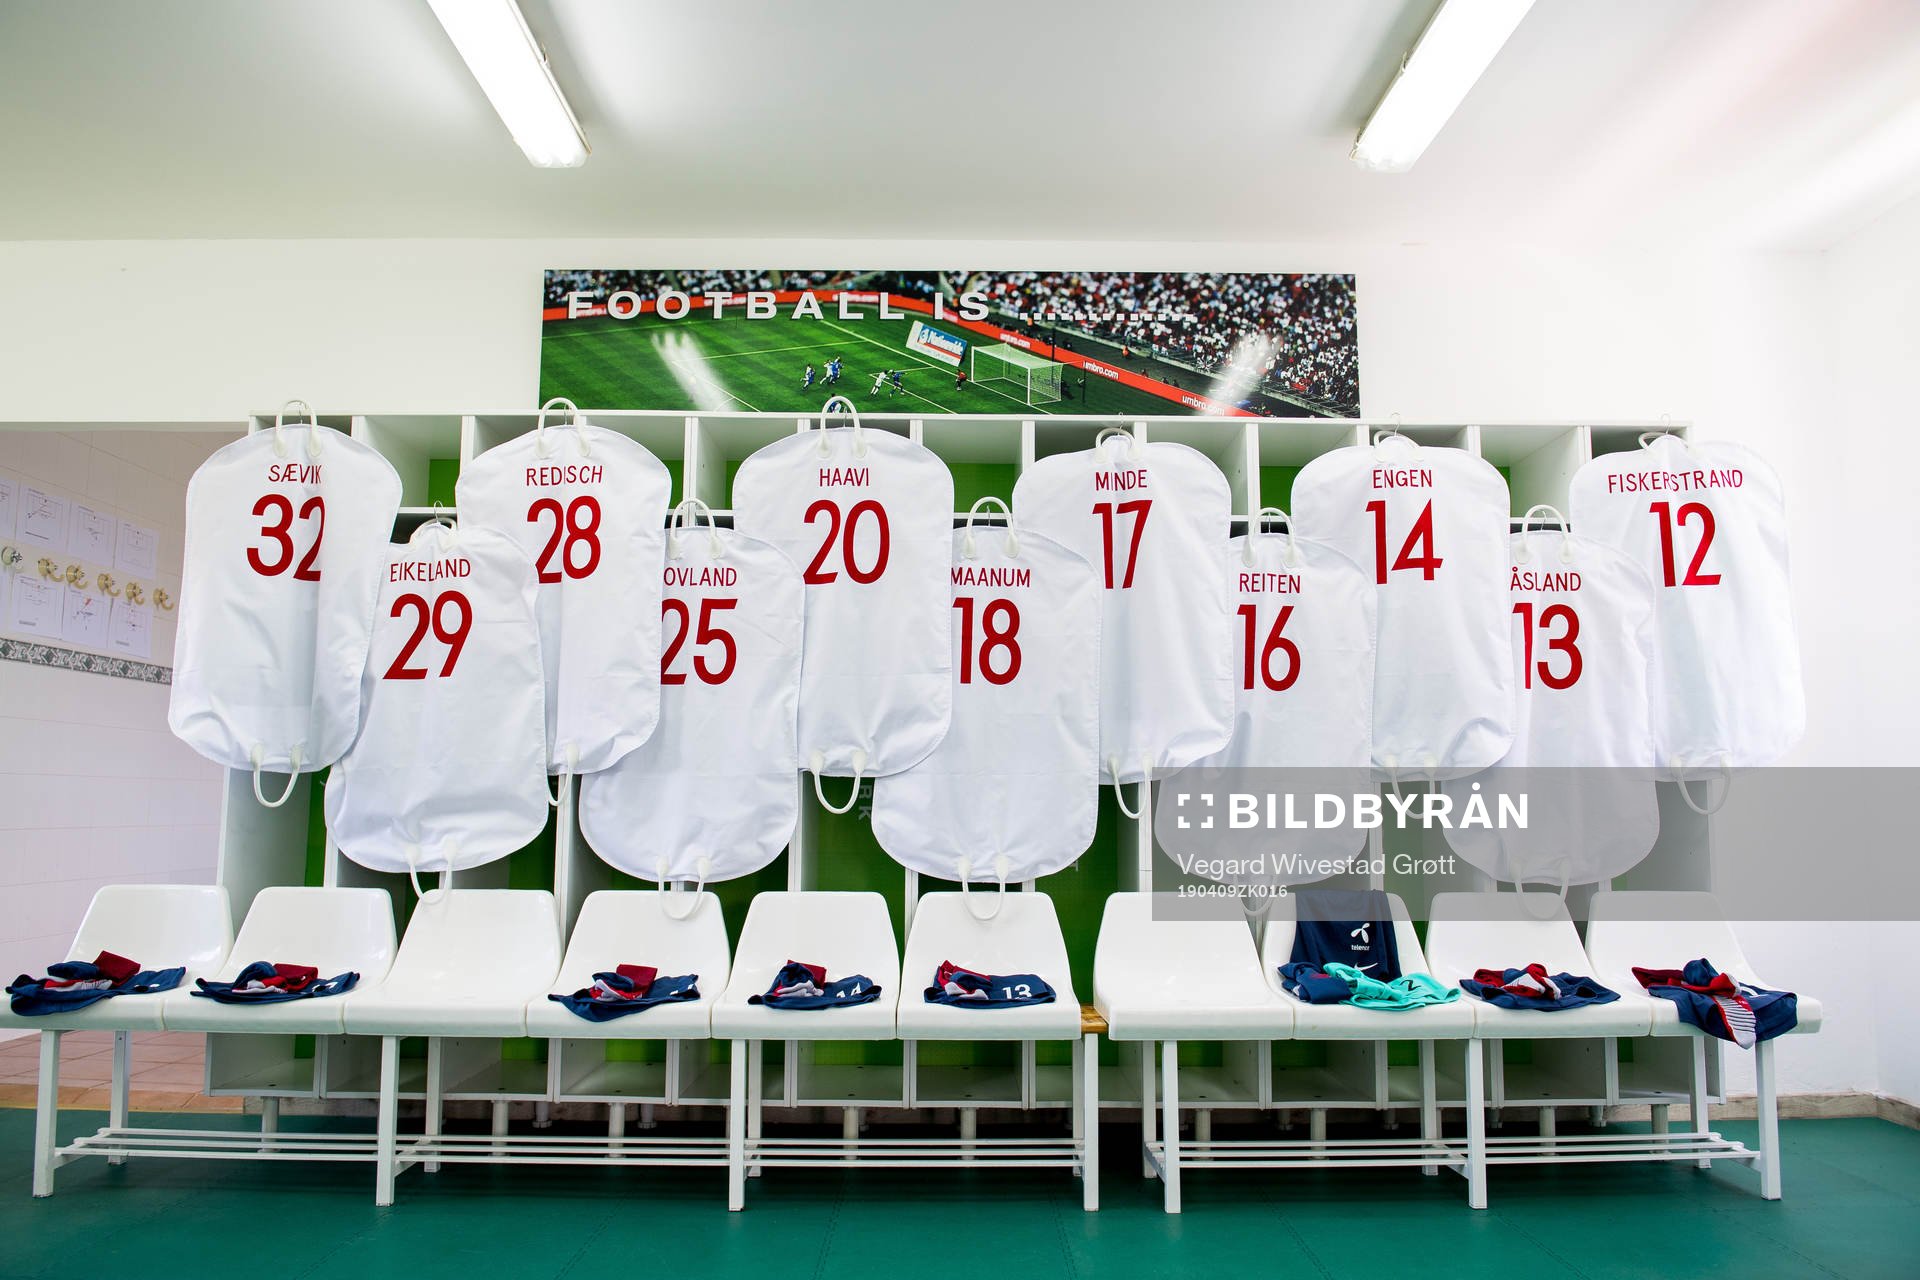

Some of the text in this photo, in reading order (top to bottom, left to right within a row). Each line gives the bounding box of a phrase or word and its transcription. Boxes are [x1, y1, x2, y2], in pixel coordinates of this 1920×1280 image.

[568, 290, 904, 320] FOOTBALL
[934, 291, 990, 321] IS
[269, 463, 323, 485] SÆVIK
[526, 464, 603, 487] REDISCH
[819, 467, 870, 487] HAAVI
[1095, 469, 1147, 491] MINDE
[1372, 468, 1433, 489] ENGEN
[1607, 469, 1743, 493] FISKERSTRAND
[246, 493, 326, 582] 32
[527, 494, 601, 584] 28
[803, 499, 890, 585] 20
[1092, 500, 1153, 589] 17
[1366, 498, 1443, 585] 14
[1649, 501, 1722, 588] 12
[390, 558, 472, 583] EIKELAND
[951, 566, 1031, 588] MAANUM
[1239, 572, 1301, 595] REITEN
[1510, 565, 1582, 592] ÅSLAND
[382, 590, 473, 680] 29
[661, 598, 738, 685] 25
[952, 596, 1022, 686] 18
[1237, 604, 1301, 692] 16
[1512, 602, 1583, 690] 13
